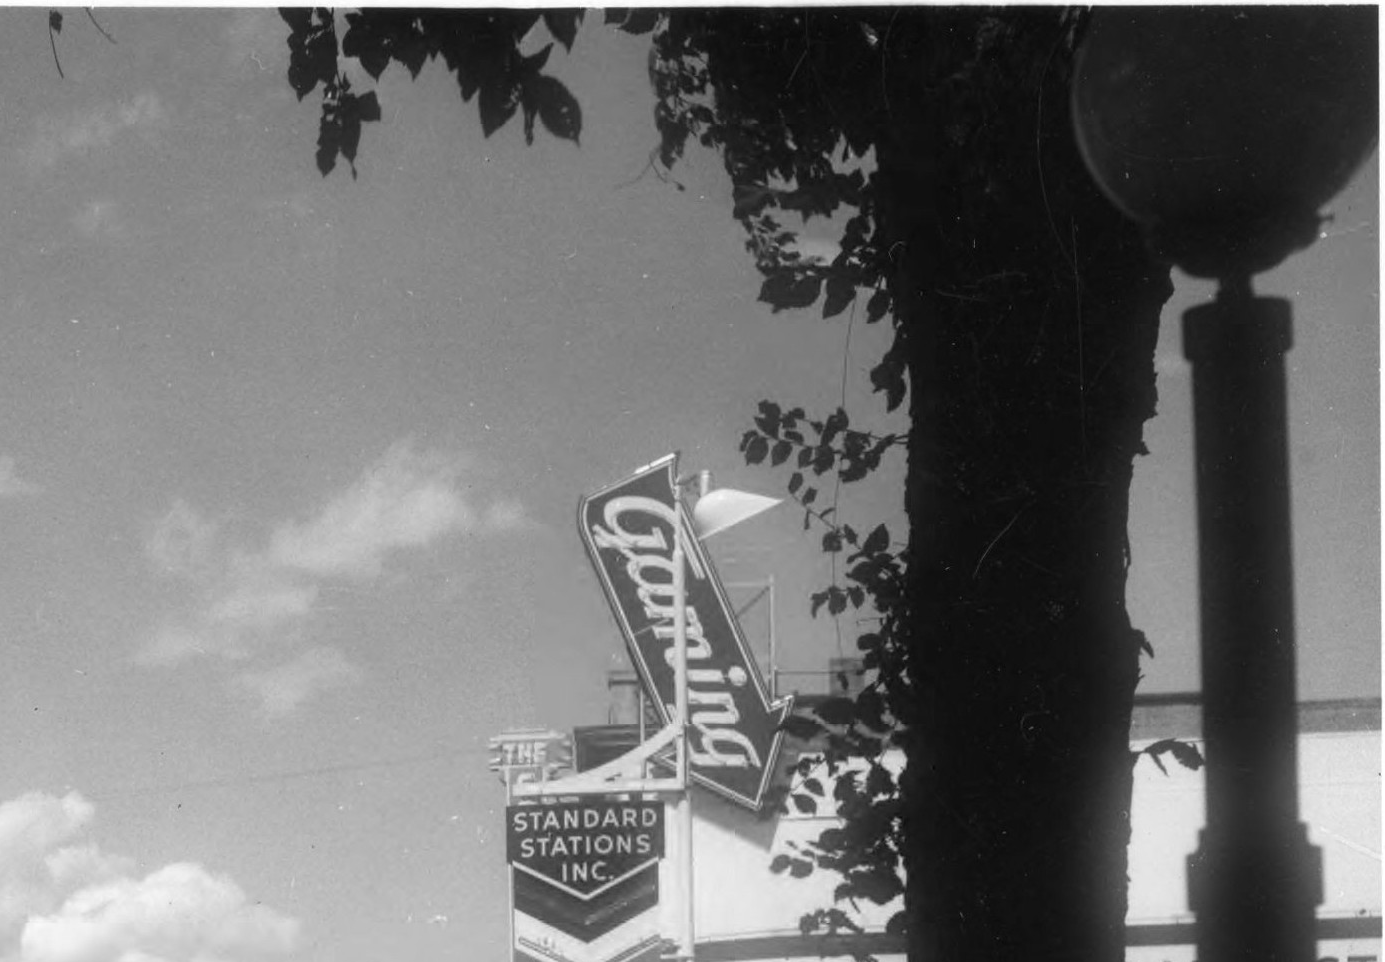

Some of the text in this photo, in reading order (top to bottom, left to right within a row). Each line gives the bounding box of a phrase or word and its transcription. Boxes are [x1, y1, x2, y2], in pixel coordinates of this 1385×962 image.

[592, 495, 762, 769] Gaming
[502, 742, 547, 764] THE
[513, 807, 658, 832] STANDARD
[520, 834, 652, 858] STATIONS
[561, 861, 615, 882] INC.
